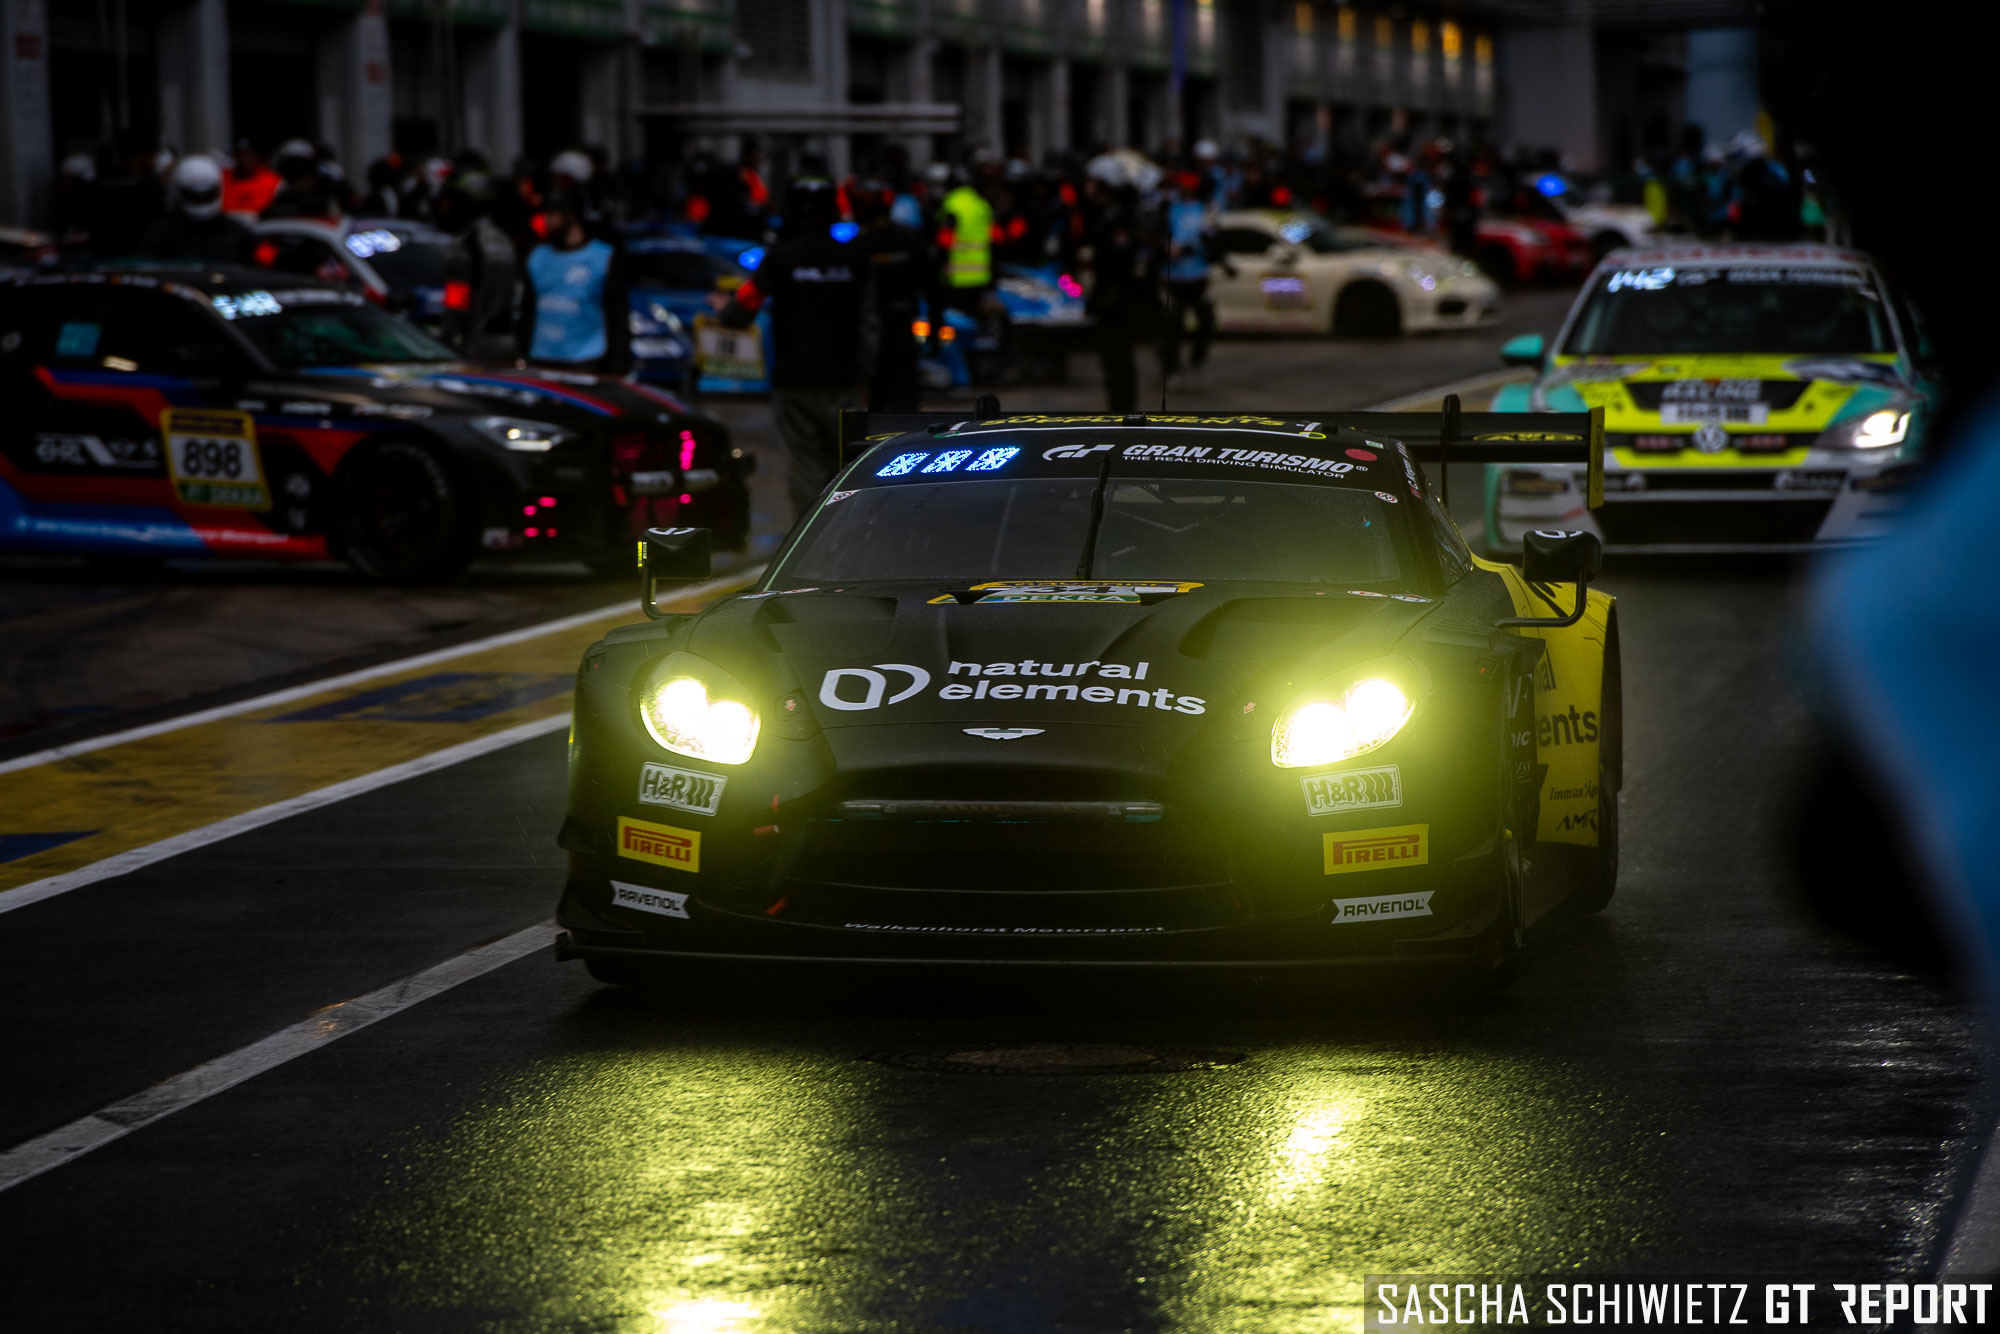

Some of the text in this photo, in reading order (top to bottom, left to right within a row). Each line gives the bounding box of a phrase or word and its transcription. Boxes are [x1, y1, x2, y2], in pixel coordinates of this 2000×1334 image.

[183, 440, 242, 478] 898
[1122, 444, 1212, 458] GRAN
[1196, 458, 1256, 468] DRIVING
[1260, 463, 1346, 479] SIMULATOR
[947, 659, 1149, 680] natural
[938, 680, 1207, 715] elements
[624, 826, 693, 862] PIRELLI
[1332, 834, 1420, 866] PIRELLI
[618, 888, 682, 911] RAVENOL
[1343, 899, 1425, 917] RAVENOL
[843, 923, 1165, 934] Walkenhorst Motorsport
